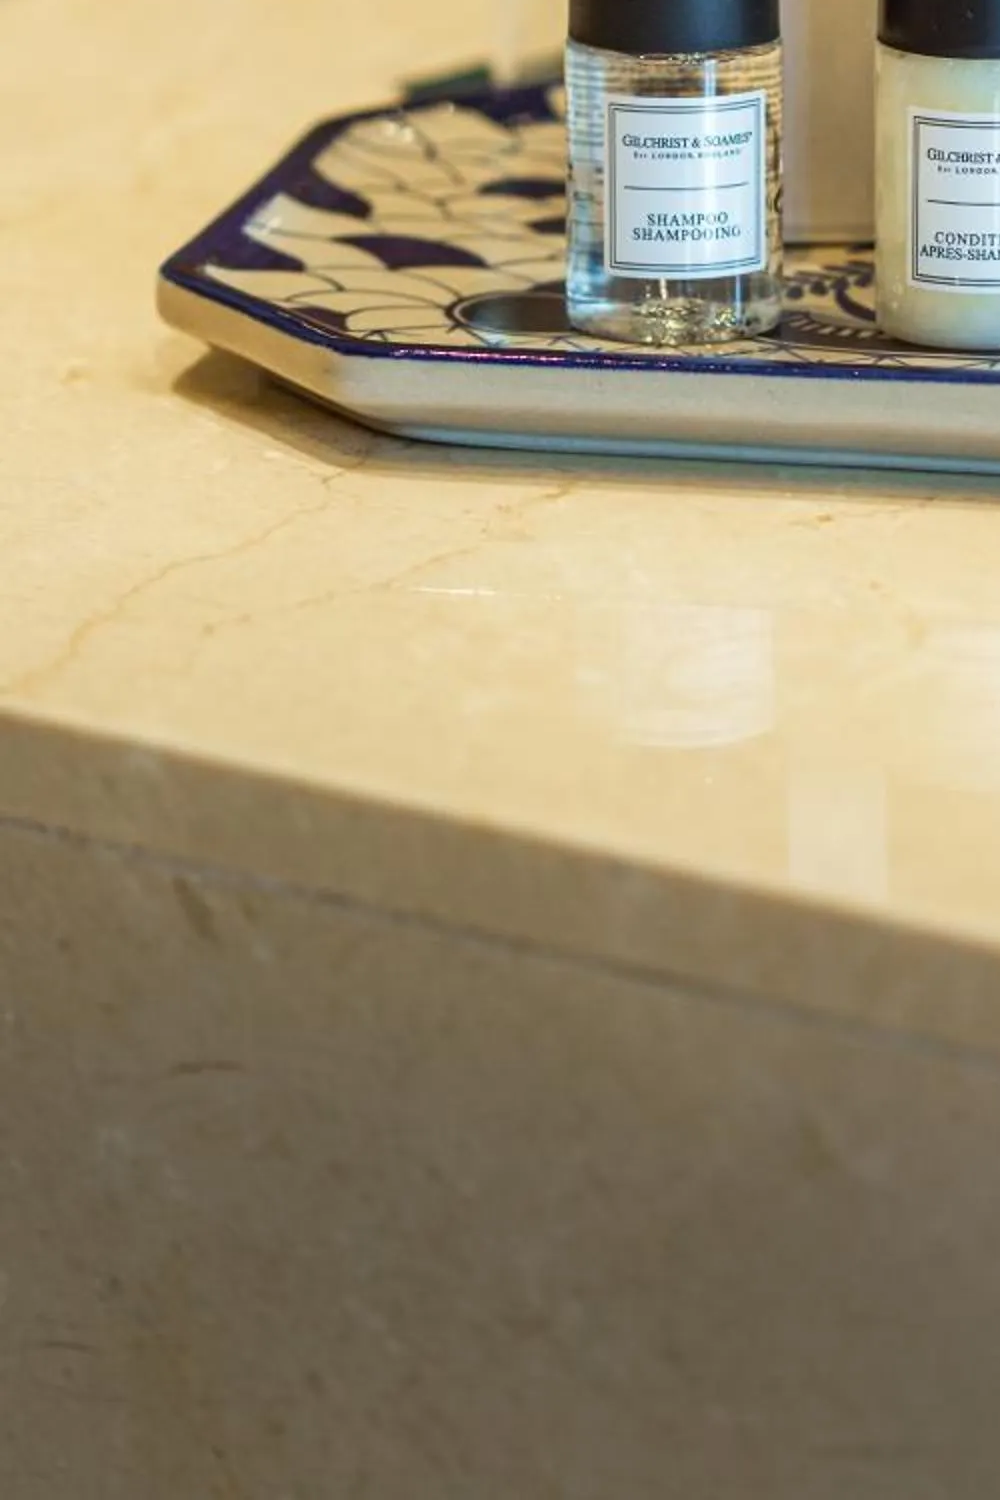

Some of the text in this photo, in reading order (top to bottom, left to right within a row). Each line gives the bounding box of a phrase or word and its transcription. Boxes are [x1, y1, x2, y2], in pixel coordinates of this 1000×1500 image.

[622, 133, 690, 149] GILCHRIST
[691, 136, 701, 149] &
[927, 147, 993, 164] GILCHRIST
[646, 211, 729, 227] SHAMPOO
[632, 225, 741, 242] SHAMPOOING
